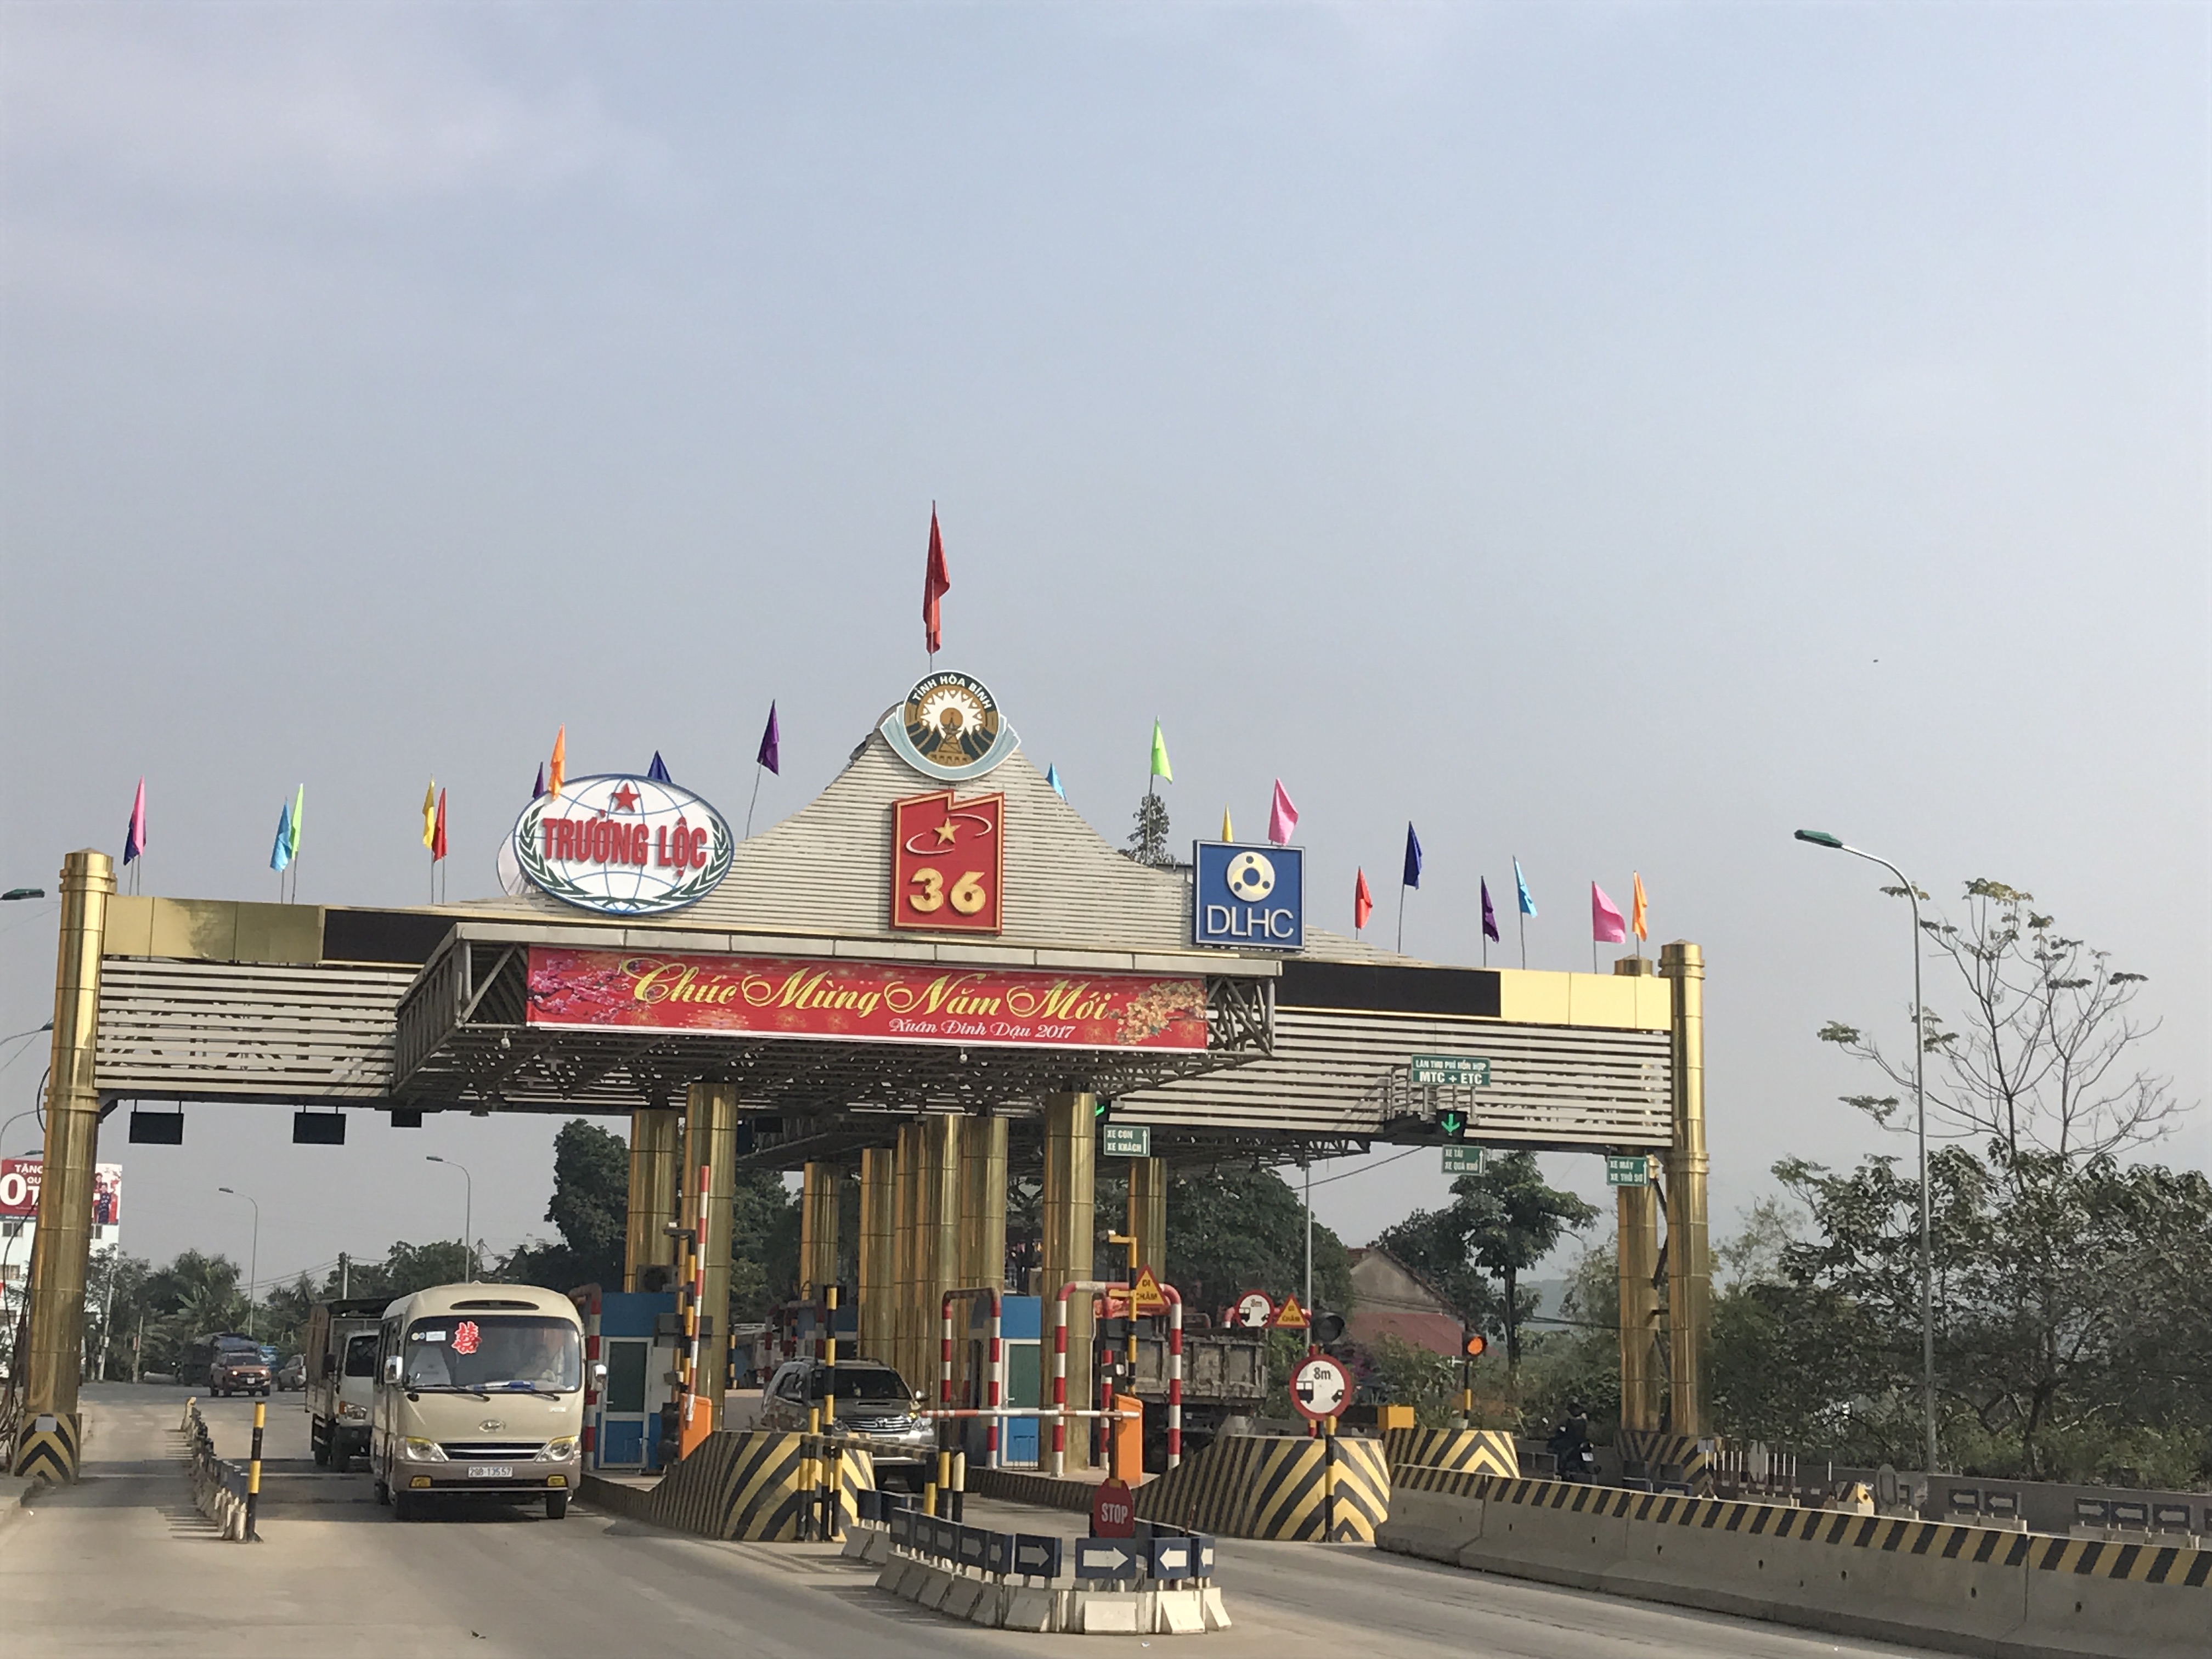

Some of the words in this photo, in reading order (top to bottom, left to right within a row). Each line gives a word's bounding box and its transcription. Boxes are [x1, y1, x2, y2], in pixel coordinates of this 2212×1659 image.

[940, 674, 965, 687] HÒA
[658, 816, 707, 877] LỘC
[909, 867, 986, 915] 36
[1207, 905, 1294, 938] DLHC
[621, 957, 737, 1005] Chúc
[742, 966, 881, 1018] Mừng
[884, 973, 1002, 1016] Năm
[1007, 980, 1111, 1020] Mới
[941, 1020, 987, 1035] Đinh
[1035, 1024, 1076, 1039] 2017
[1415, 1059, 1429, 1068] LÀN
[1430, 1060, 1443, 1069] THU
[1419, 1071, 1446, 1083] MTC
[1460, 1073, 1482, 1085] ETC
[1107, 1130, 1116, 1138] XE
[1118, 1130, 1133, 1139] CON
[1107, 1142, 1116, 1152] XE
[1118, 1142, 1142, 1153] KHÁCH
[1445, 1149, 1453, 1157] XE
[1444, 1161, 1453, 1170] XE
[1610, 1160, 1618, 1169] XE
[1610, 1173, 1619, 1182] XE
[1313, 1367, 1331, 1380] 8m
[1101, 1502, 1128, 1525] STOP
